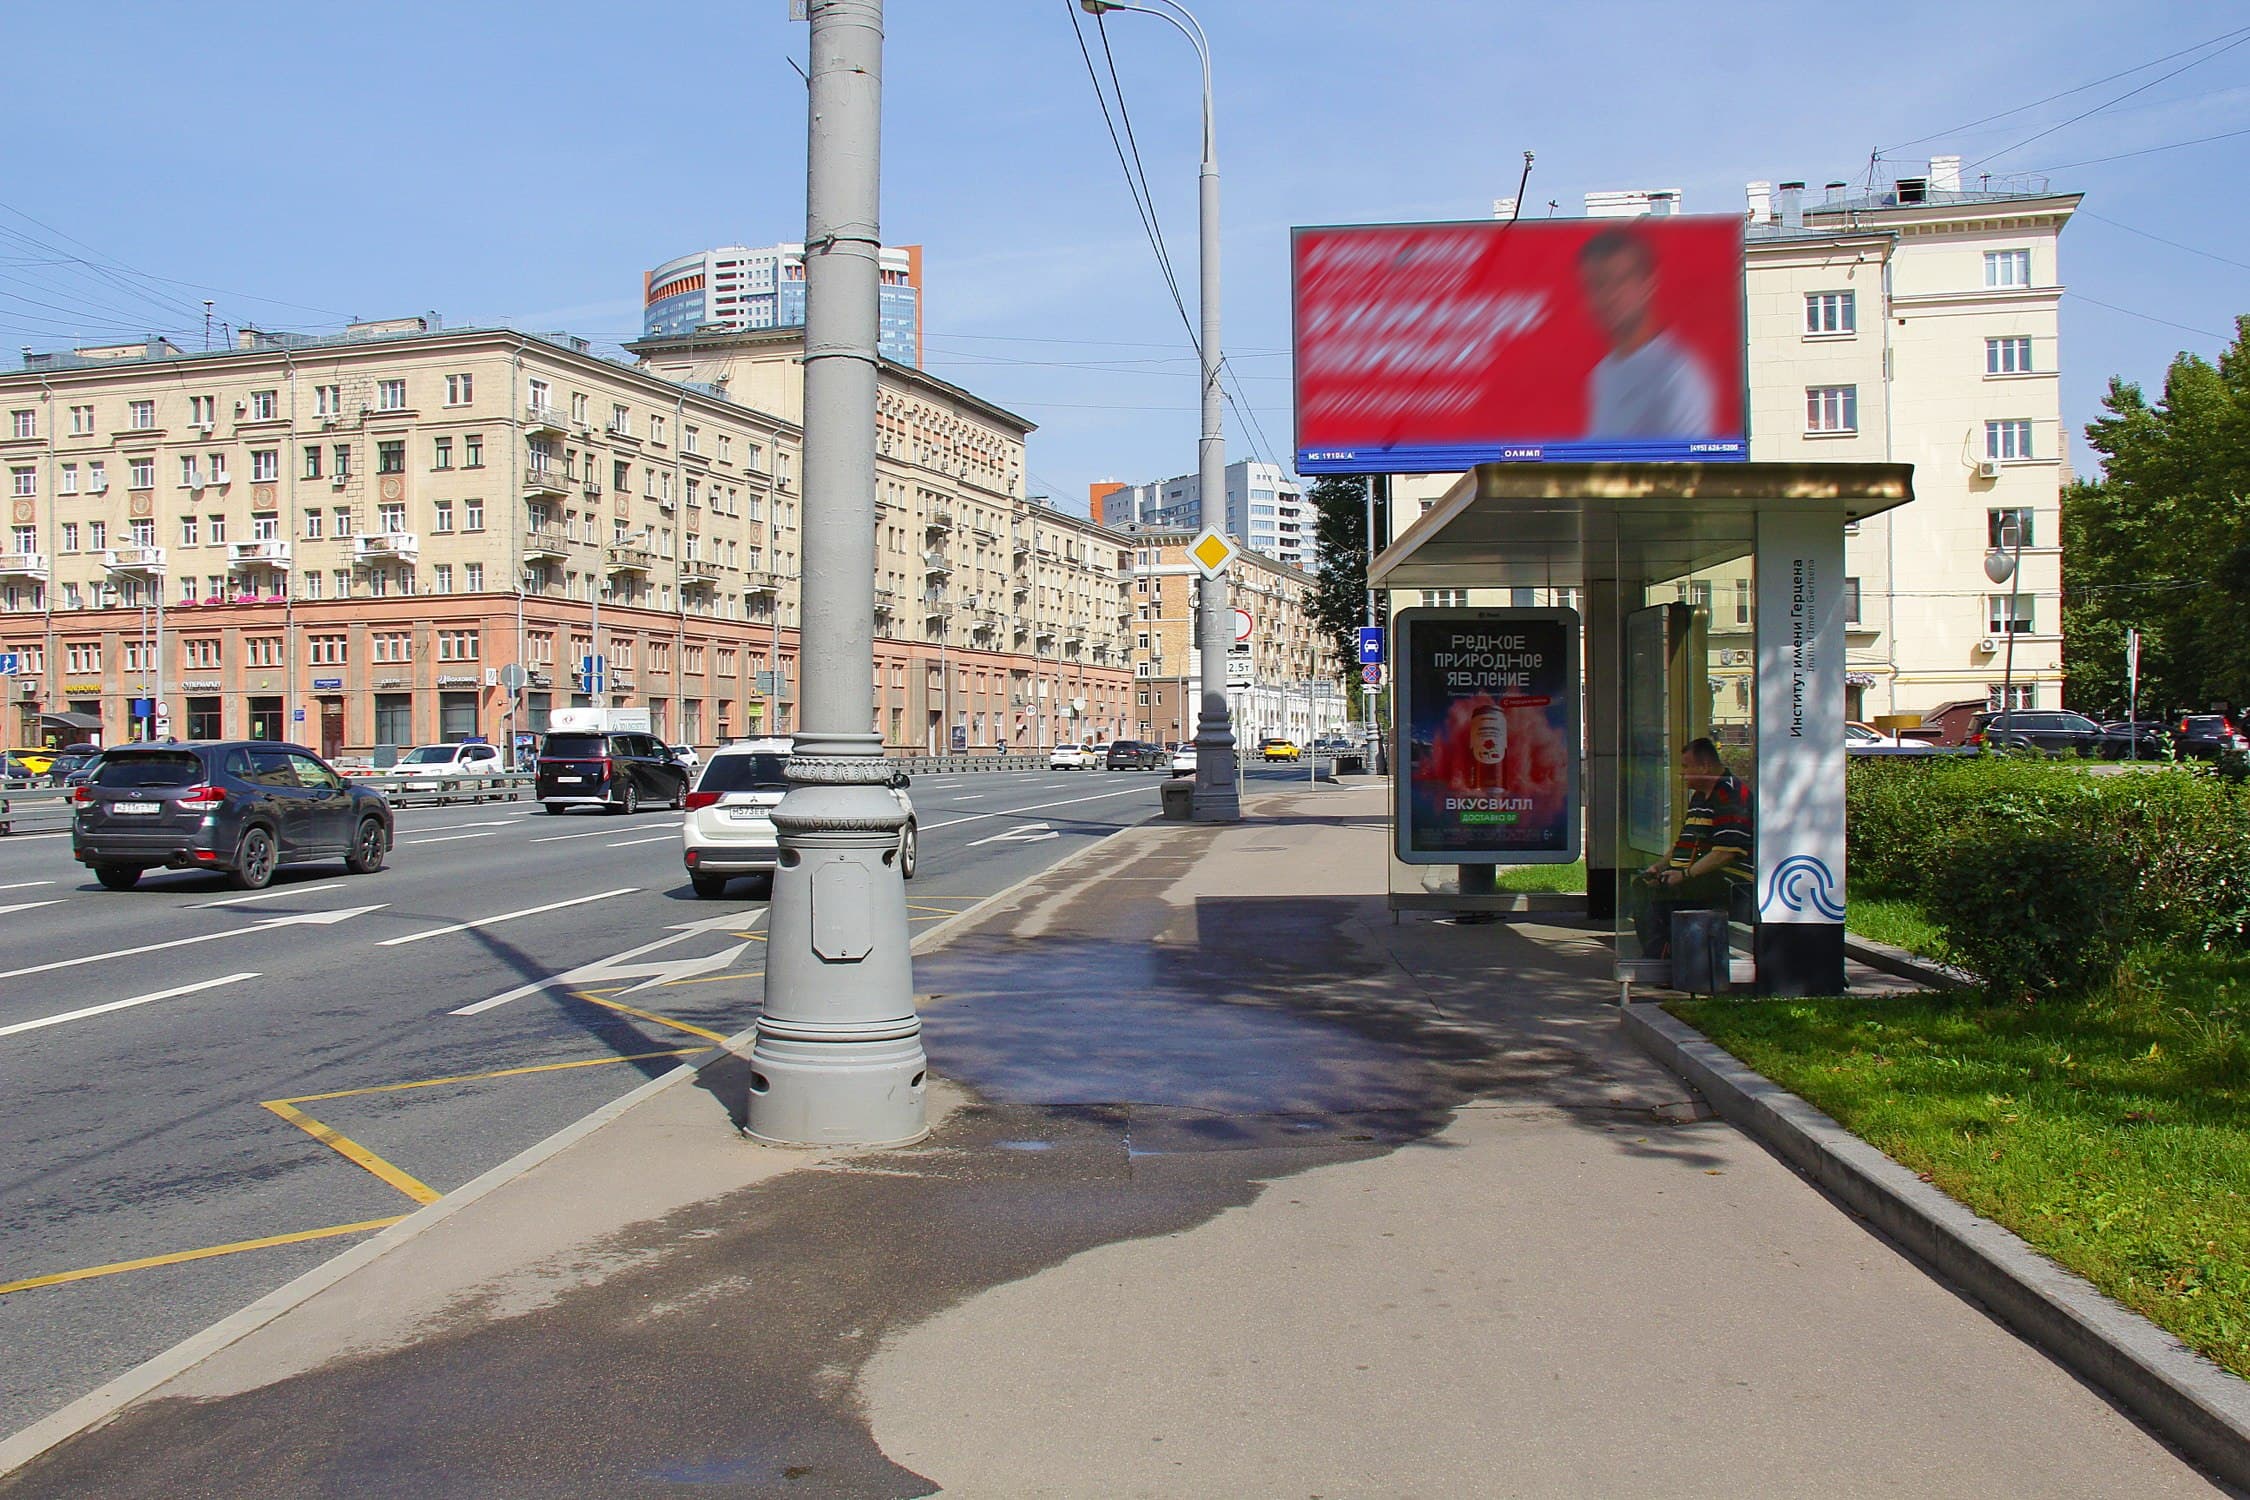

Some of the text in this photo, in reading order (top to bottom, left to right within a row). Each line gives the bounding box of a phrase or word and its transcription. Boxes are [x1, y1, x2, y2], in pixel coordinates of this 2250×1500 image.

[1504, 449, 1541, 457] ОЛИМП
[1790, 559, 1805, 737] Институт имени Герцена
[1445, 798, 1533, 810] ВКУСВИЛЛ
